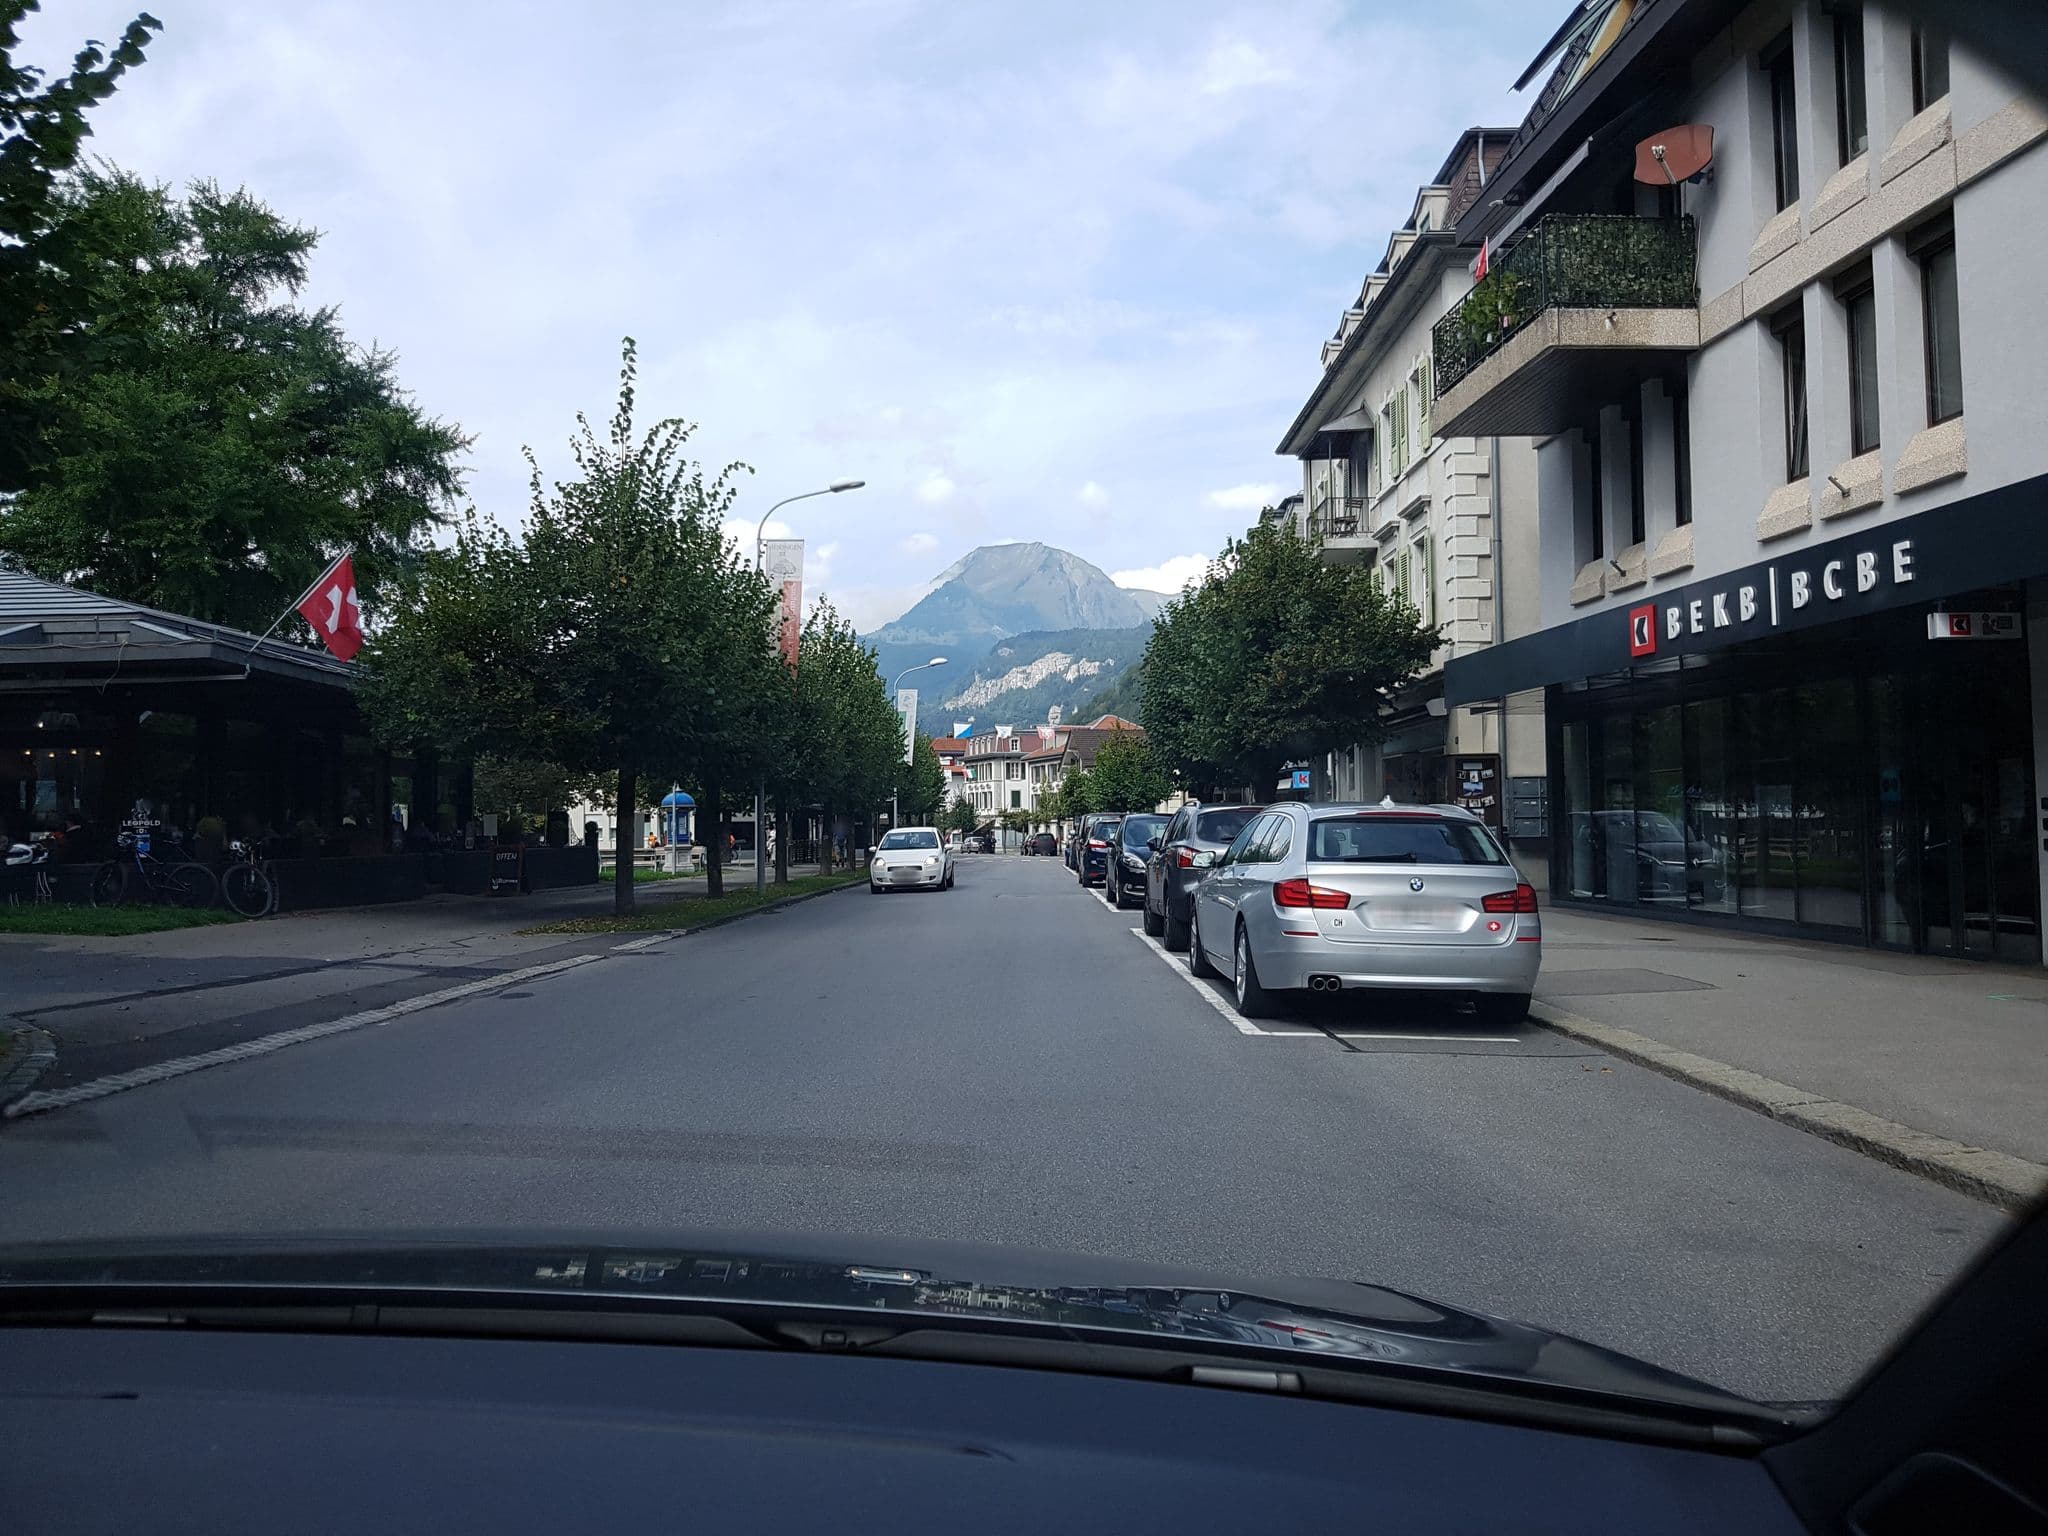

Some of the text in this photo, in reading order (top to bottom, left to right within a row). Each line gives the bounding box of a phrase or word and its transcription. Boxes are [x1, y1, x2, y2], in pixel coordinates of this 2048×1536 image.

[1666, 540, 1914, 640] BEKB BCBE
[1333, 918, 1343, 927] CH
